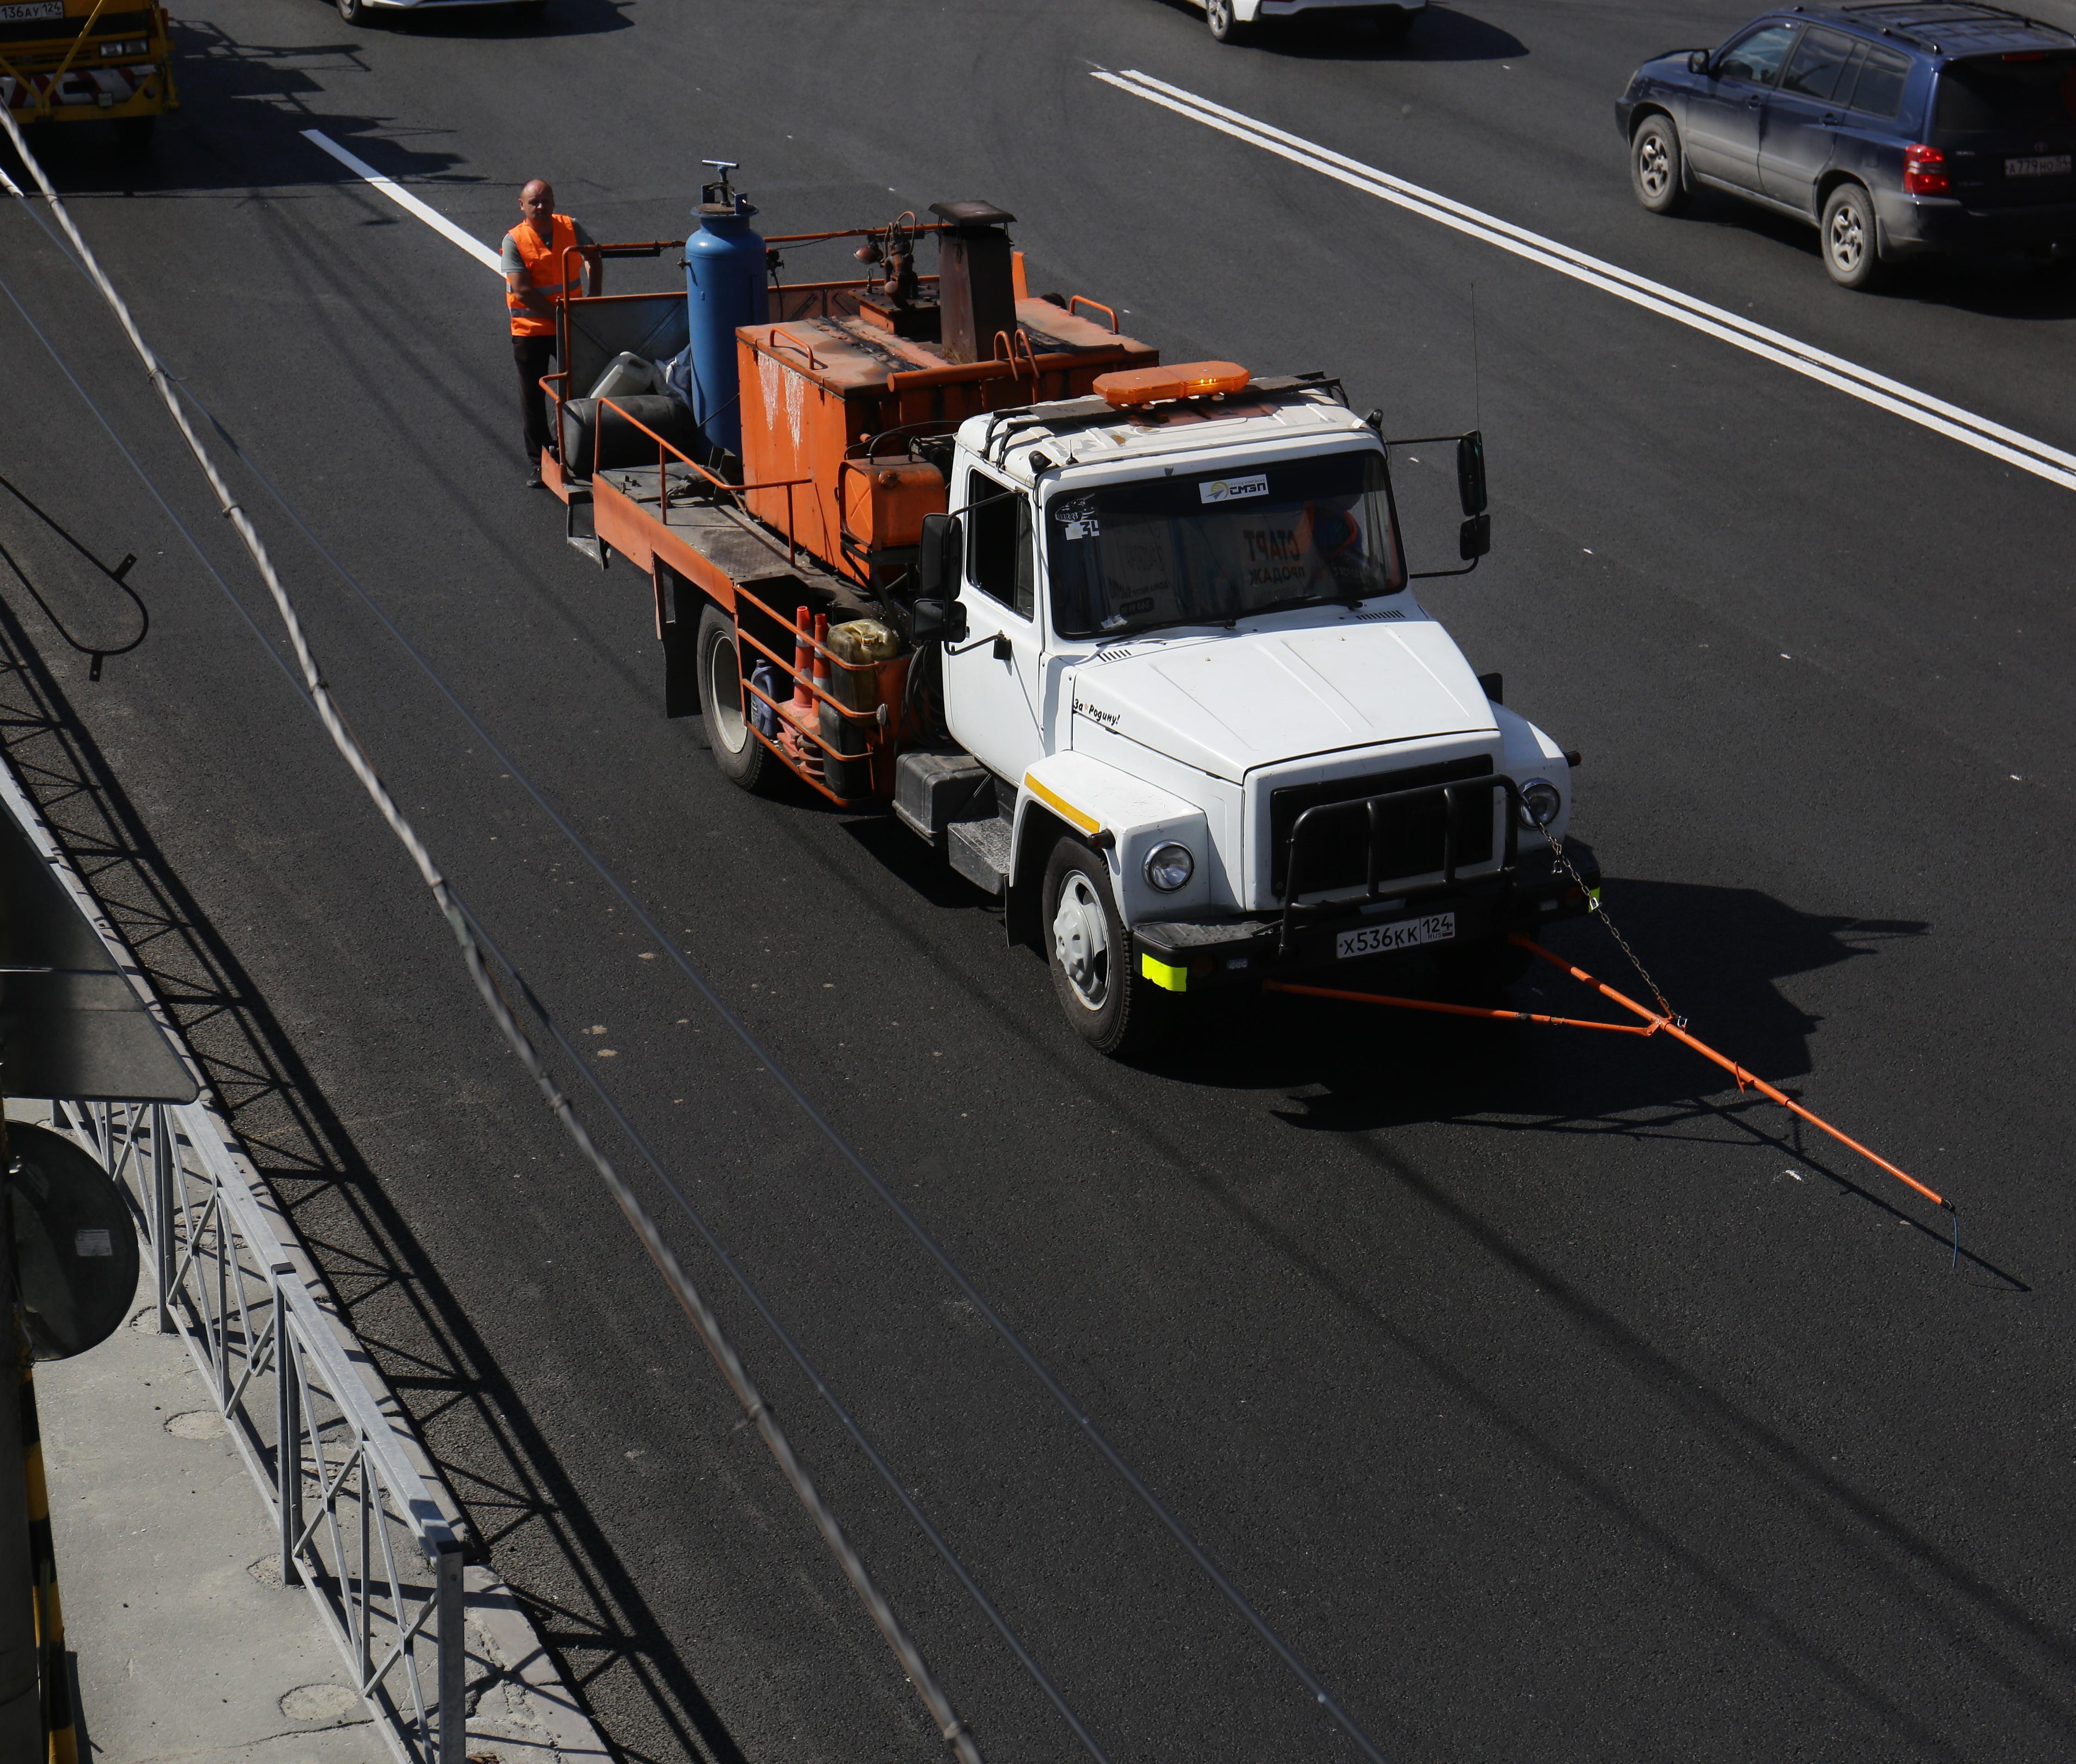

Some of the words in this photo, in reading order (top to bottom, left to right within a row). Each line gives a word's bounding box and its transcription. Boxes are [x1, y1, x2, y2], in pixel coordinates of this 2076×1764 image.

[42, 3, 60, 12] 124
[1229, 482, 1266, 495] СМЭП
[1073, 698, 1083, 711] За
[1089, 704, 1120, 726] Родину!
[1423, 916, 1451, 932] 124
[1428, 932, 1442, 940] RUS
